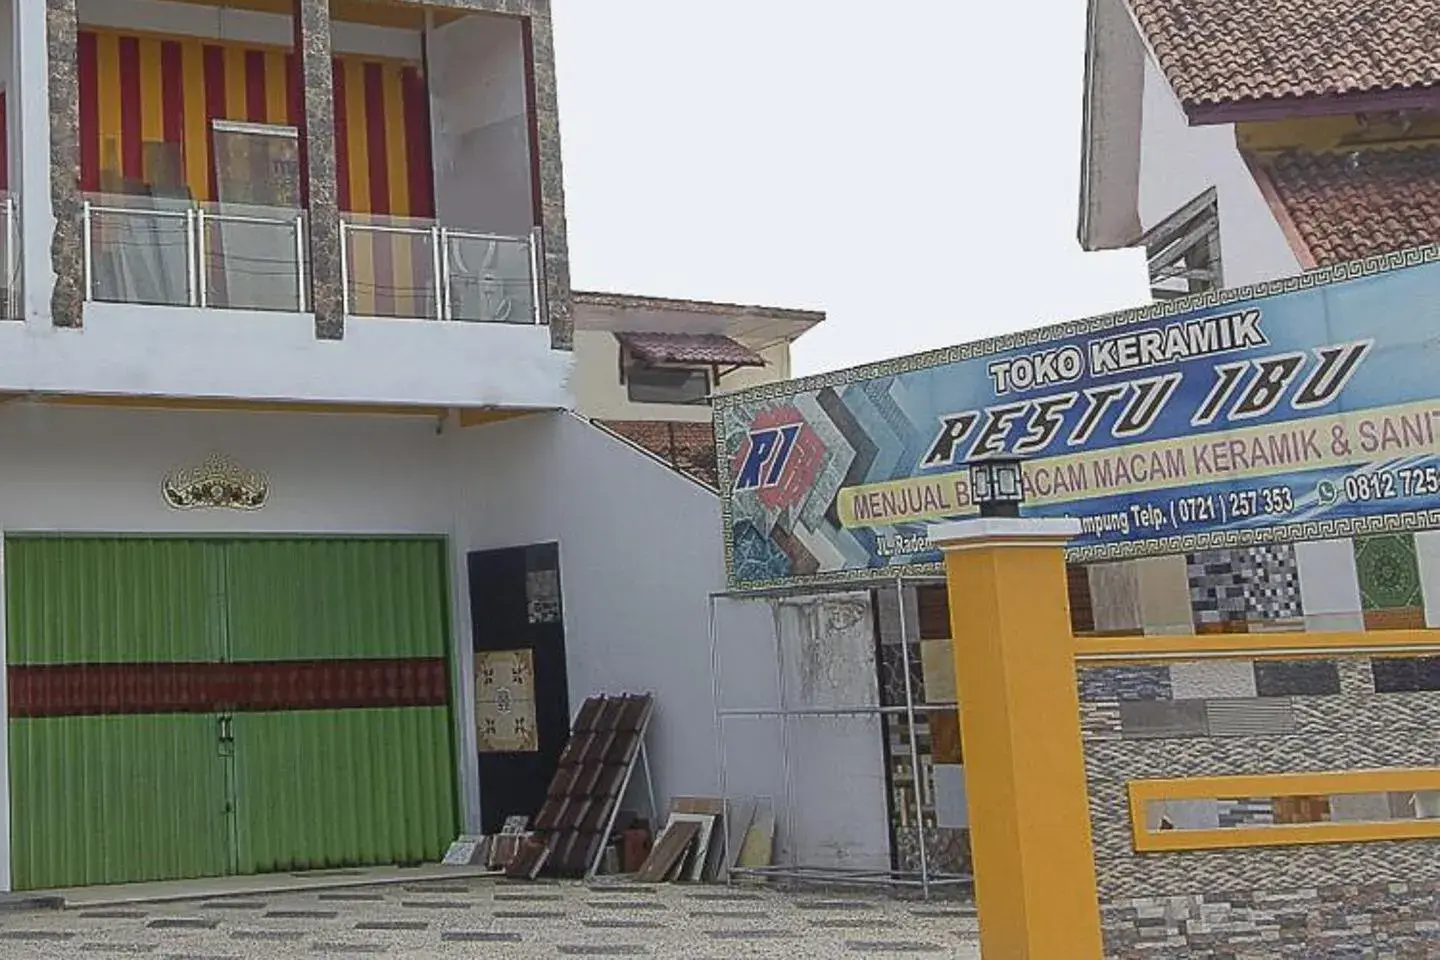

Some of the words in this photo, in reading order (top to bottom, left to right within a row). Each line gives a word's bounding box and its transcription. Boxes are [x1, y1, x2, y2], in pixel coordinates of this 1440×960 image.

[989, 344, 1085, 395] TOKO
[1089, 308, 1268, 376] KERAMIK
[919, 373, 1183, 469] RESTU
[1190, 339, 1375, 426] IBU
[853, 480, 951, 521] MENJUAL
[1093, 449, 1187, 489] MACAM
[1193, 429, 1322, 475] KERAMIK
[1331, 424, 1352, 457] &
[1359, 410, 1440, 452] SANI
[1130, 502, 1167, 530] Telp.
[1229, 491, 1258, 517] 257
[1262, 486, 1294, 514] 353
[1345, 471, 1397, 502] 0812
